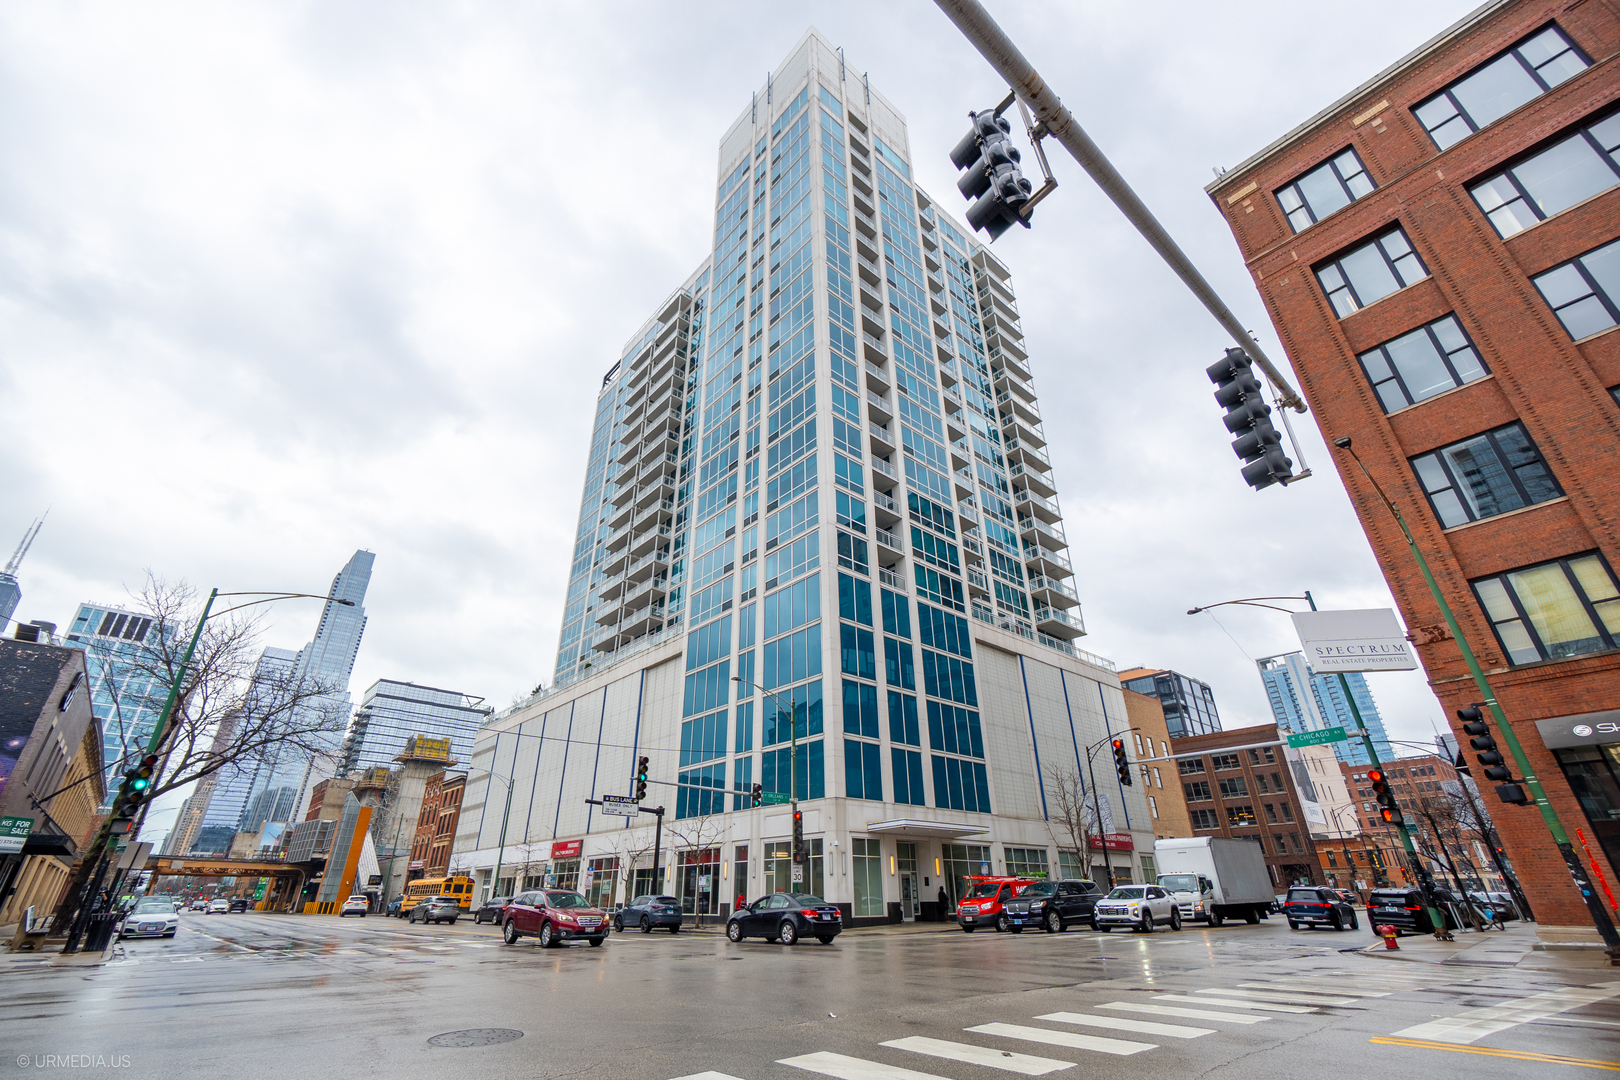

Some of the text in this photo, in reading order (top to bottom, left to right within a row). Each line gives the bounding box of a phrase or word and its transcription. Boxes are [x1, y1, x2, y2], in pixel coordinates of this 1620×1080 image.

[1315, 644, 1405, 655] SPECTRUM
[1299, 730, 1330, 741] CHICAGO
[793, 873, 802, 881] 30
